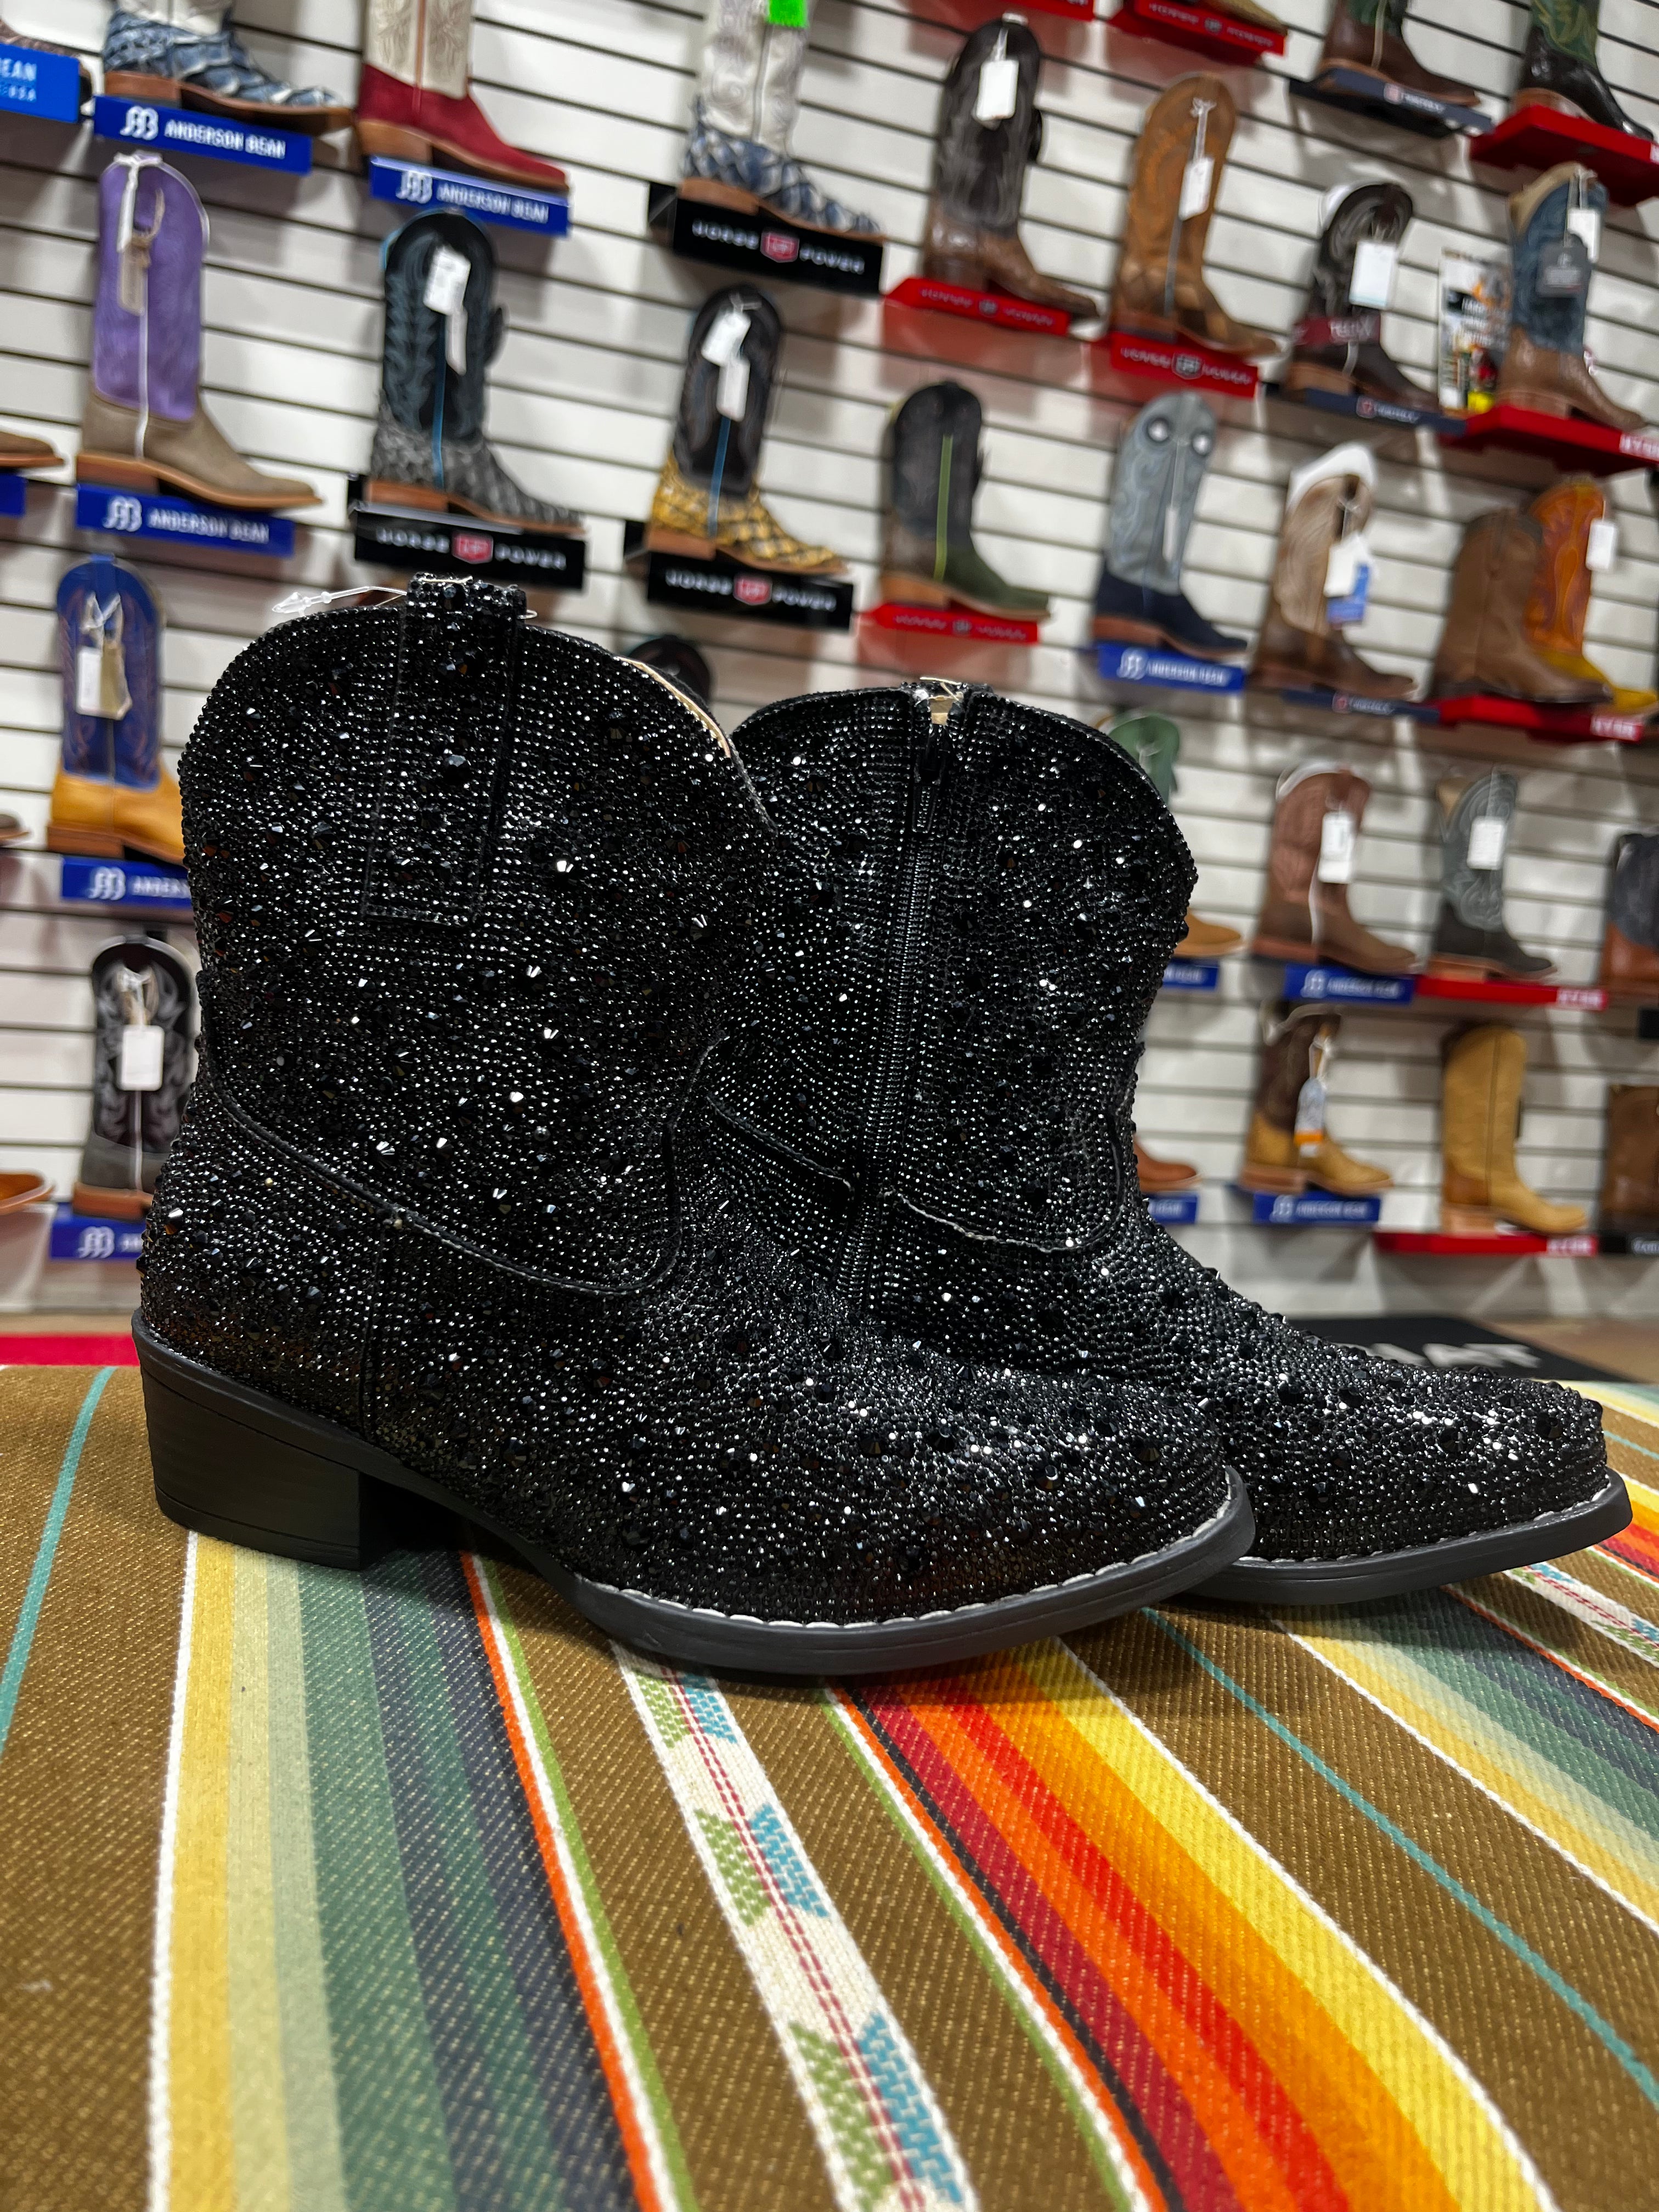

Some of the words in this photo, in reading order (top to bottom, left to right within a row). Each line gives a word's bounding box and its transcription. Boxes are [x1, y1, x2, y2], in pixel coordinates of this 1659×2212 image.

[0, 57, 37, 81] EAN
[164, 119, 245, 151] ANDERSON
[245, 133, 286, 159] BEAN
[436, 183, 511, 216] ANDERSON
[511, 199, 549, 224] BEAN
[146, 508, 228, 539] ANDERSON
[228, 519, 269, 545] BEAN
